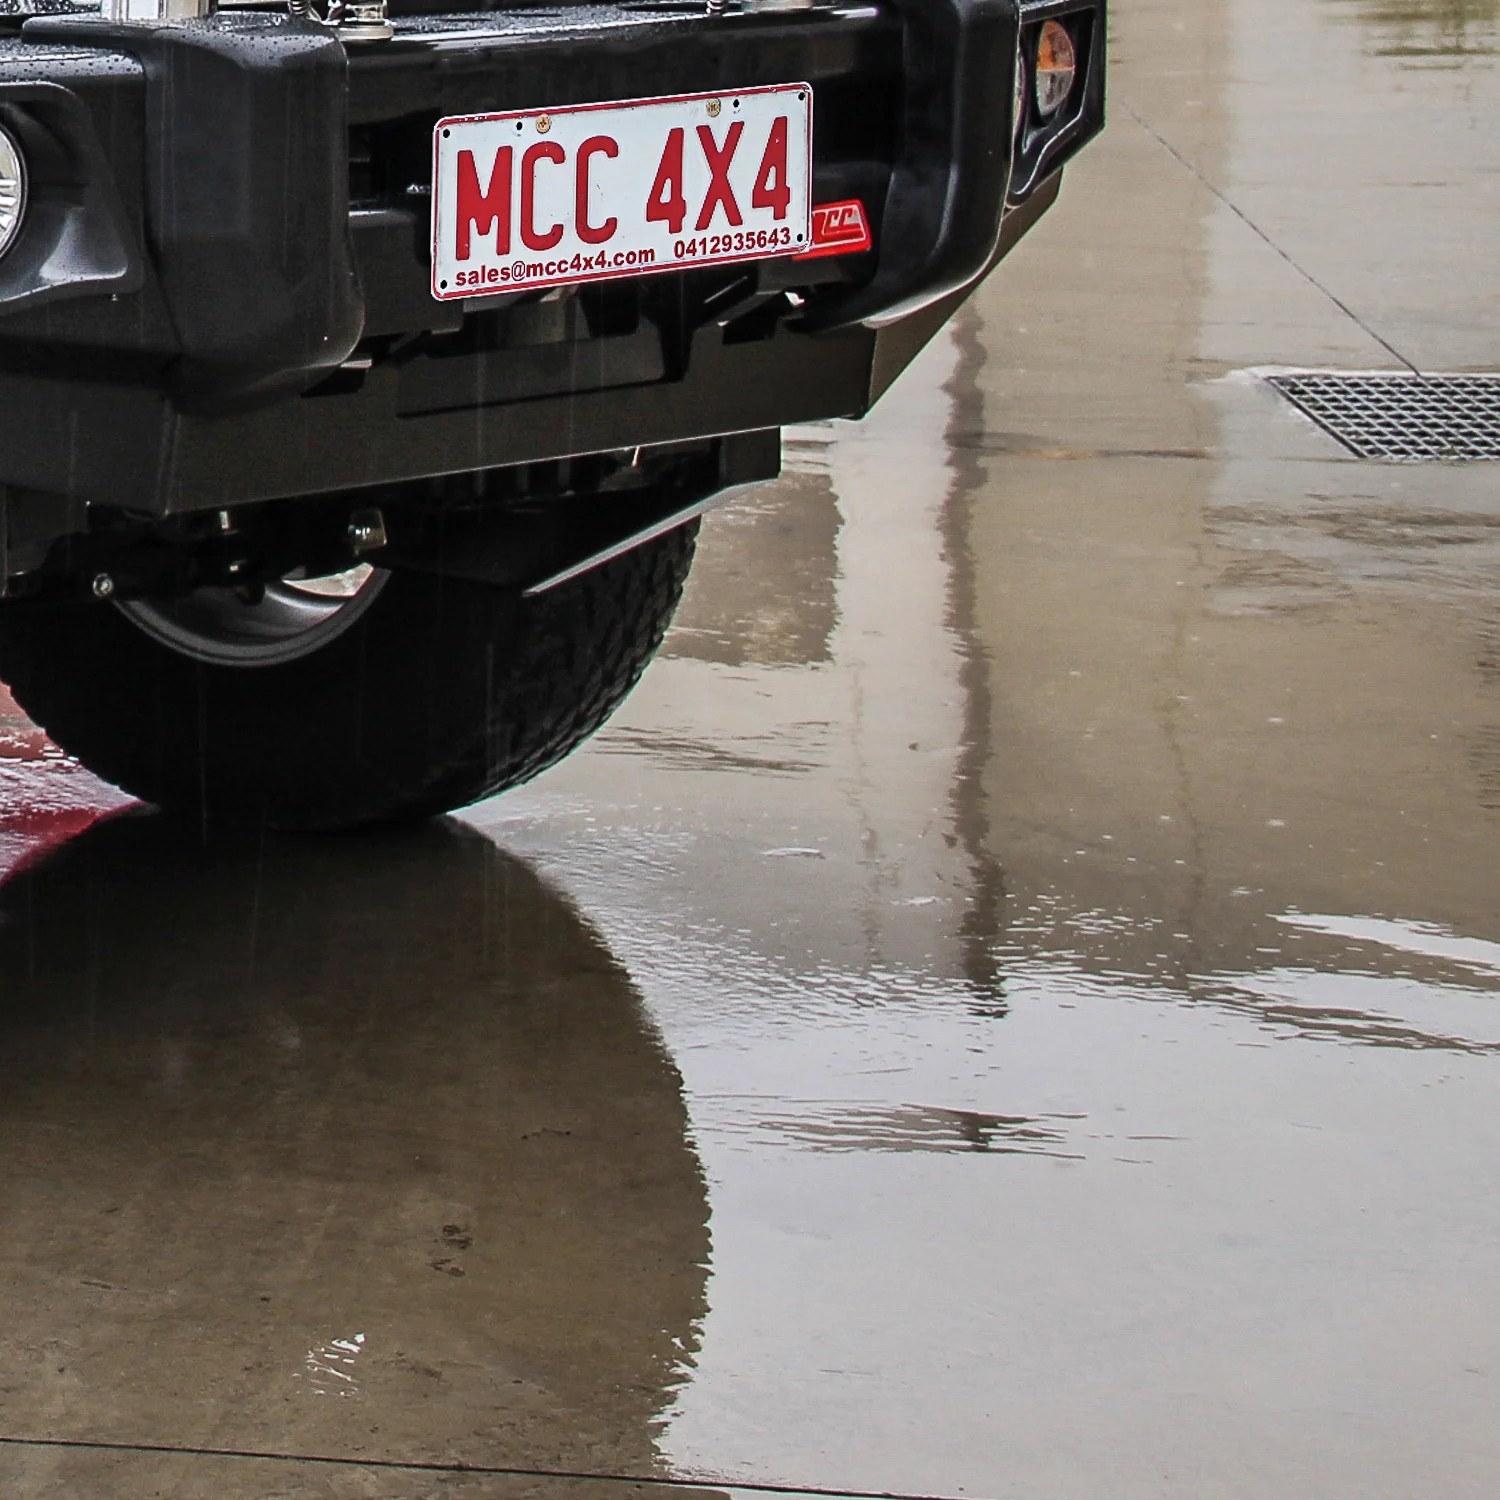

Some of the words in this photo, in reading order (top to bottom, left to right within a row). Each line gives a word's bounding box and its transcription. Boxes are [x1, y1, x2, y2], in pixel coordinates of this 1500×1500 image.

[456, 135, 619, 261] MCC
[646, 116, 791, 234] 4X4
[455, 247, 656, 287] sales@mcc4x4.com
[674, 227, 791, 259] 0412935643
